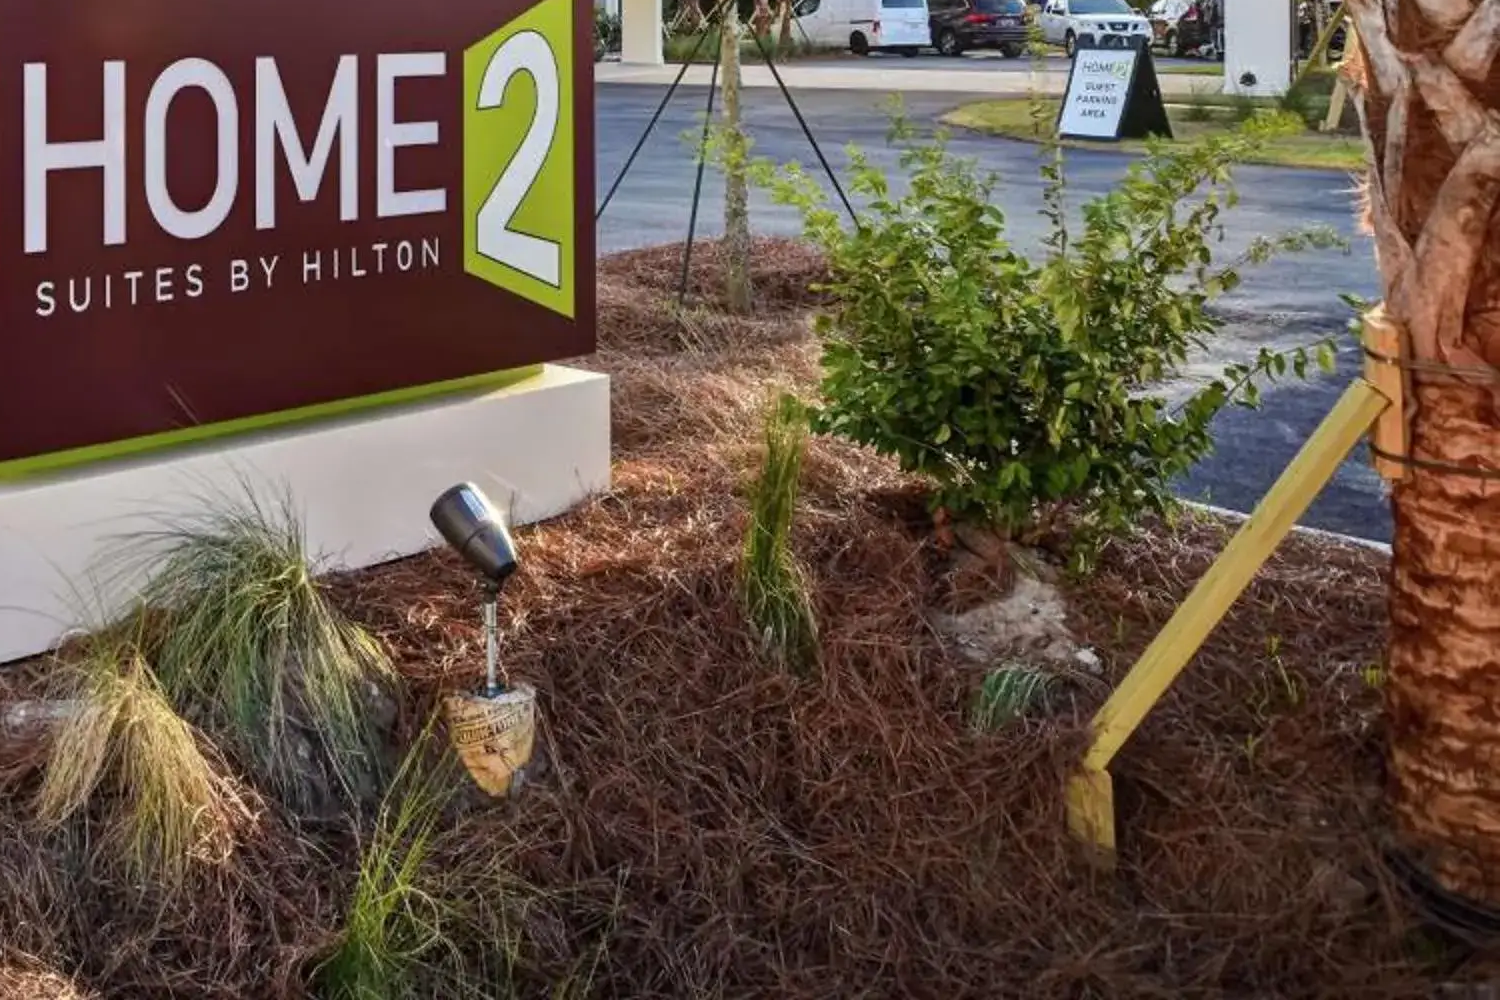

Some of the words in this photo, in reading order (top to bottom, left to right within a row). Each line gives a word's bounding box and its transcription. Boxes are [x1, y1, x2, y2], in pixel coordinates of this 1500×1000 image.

[1076, 95, 1117, 105] PARKING
[1080, 108, 1106, 118] AREA
[23, 52, 447, 253] HOME
[35, 264, 203, 317] SUITES
[231, 256, 279, 293] BY
[303, 237, 440, 284] HILTON
